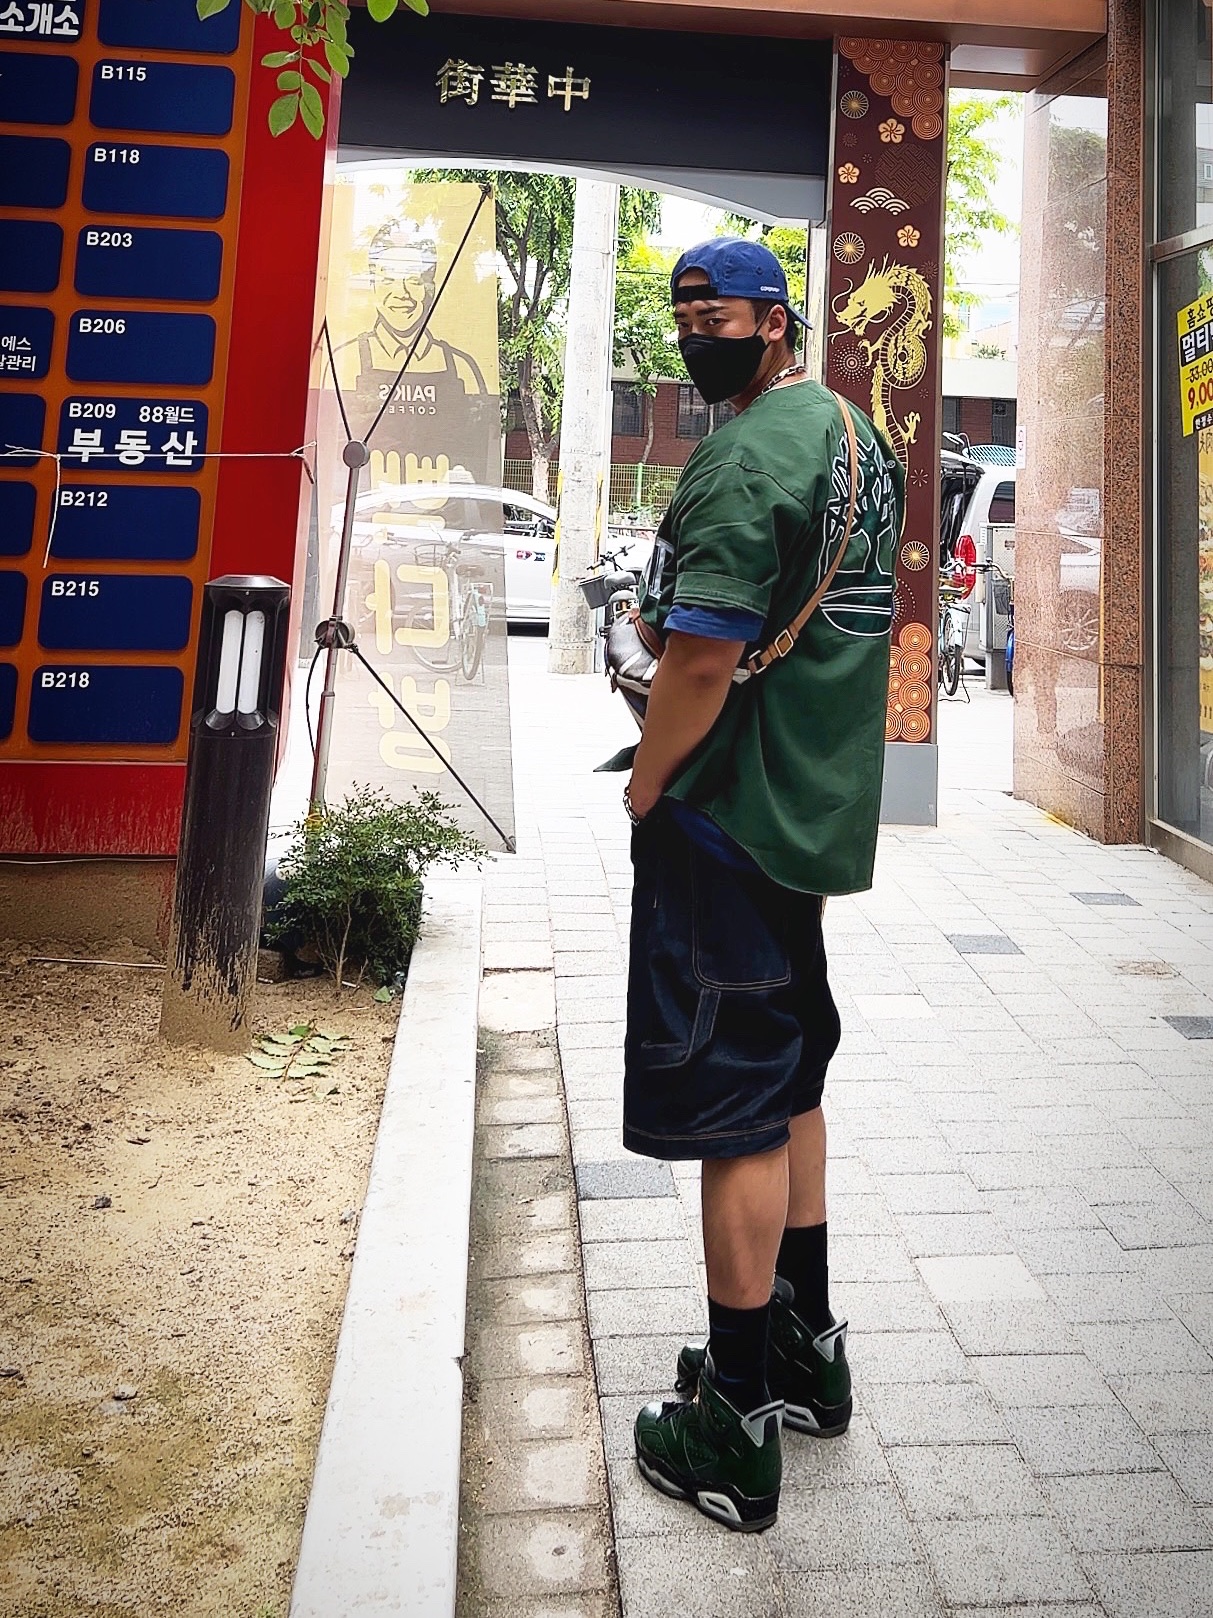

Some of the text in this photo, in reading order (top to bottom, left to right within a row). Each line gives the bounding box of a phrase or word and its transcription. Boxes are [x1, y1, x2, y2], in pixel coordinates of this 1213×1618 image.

[0, 1, 80, 36] 소개소
[101, 65, 147, 82] B115
[94, 147, 140, 164] B118
[86, 231, 133, 248] B203
[79, 318, 126, 334] B206
[1182, 322, 1213, 363] 멀티
[68, 403, 195, 424] B209 88월드
[60, 490, 108, 507] B212
[51, 580, 100, 597] B215
[41, 672, 90, 688] B218
